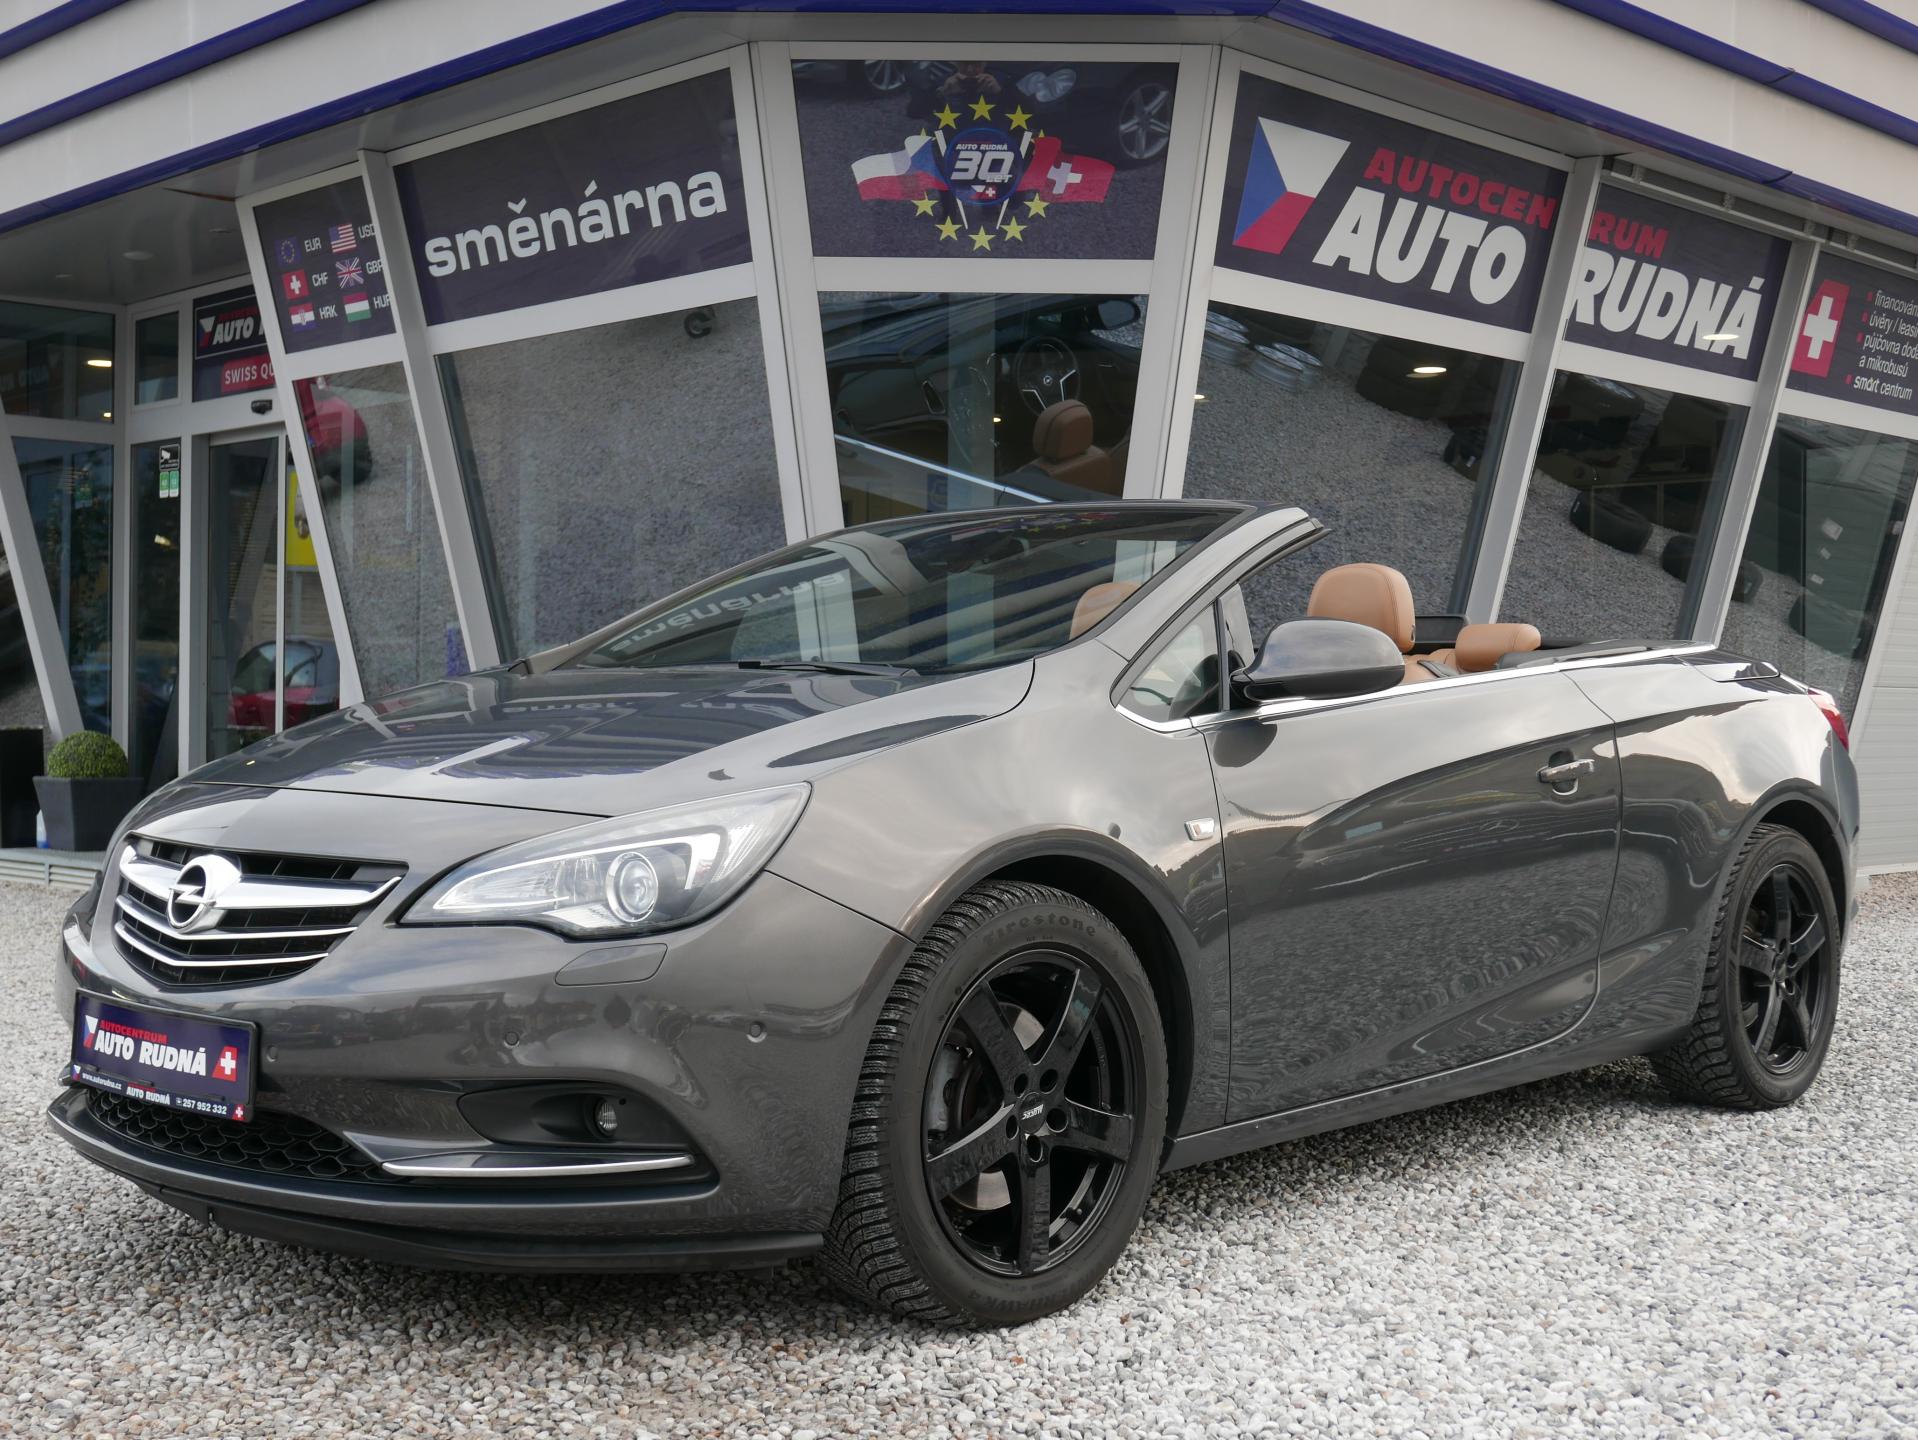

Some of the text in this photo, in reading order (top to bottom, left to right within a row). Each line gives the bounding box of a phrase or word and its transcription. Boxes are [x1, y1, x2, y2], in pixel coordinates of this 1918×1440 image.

[950, 151, 1015, 180] 30
[424, 171, 728, 277] směnárna
[304, 237, 322, 252] EUR
[312, 272, 329, 287] CHF
[1312, 186, 1766, 360] AUTO RUDNÁ
[319, 304, 337, 320] HRK
[211, 316, 255, 345] AUTO
[1859, 354, 1866, 367] a
[224, 365, 258, 385] SWISS
[1880, 382, 1913, 401] centrum
[99, 1020, 168, 1045] AUTOCENTRUM
[94, 1030, 207, 1076] AUTO RUDNÁ
[126, 1086, 145, 1099] AUTO
[183, 1098, 228, 1115] 257 952 332
